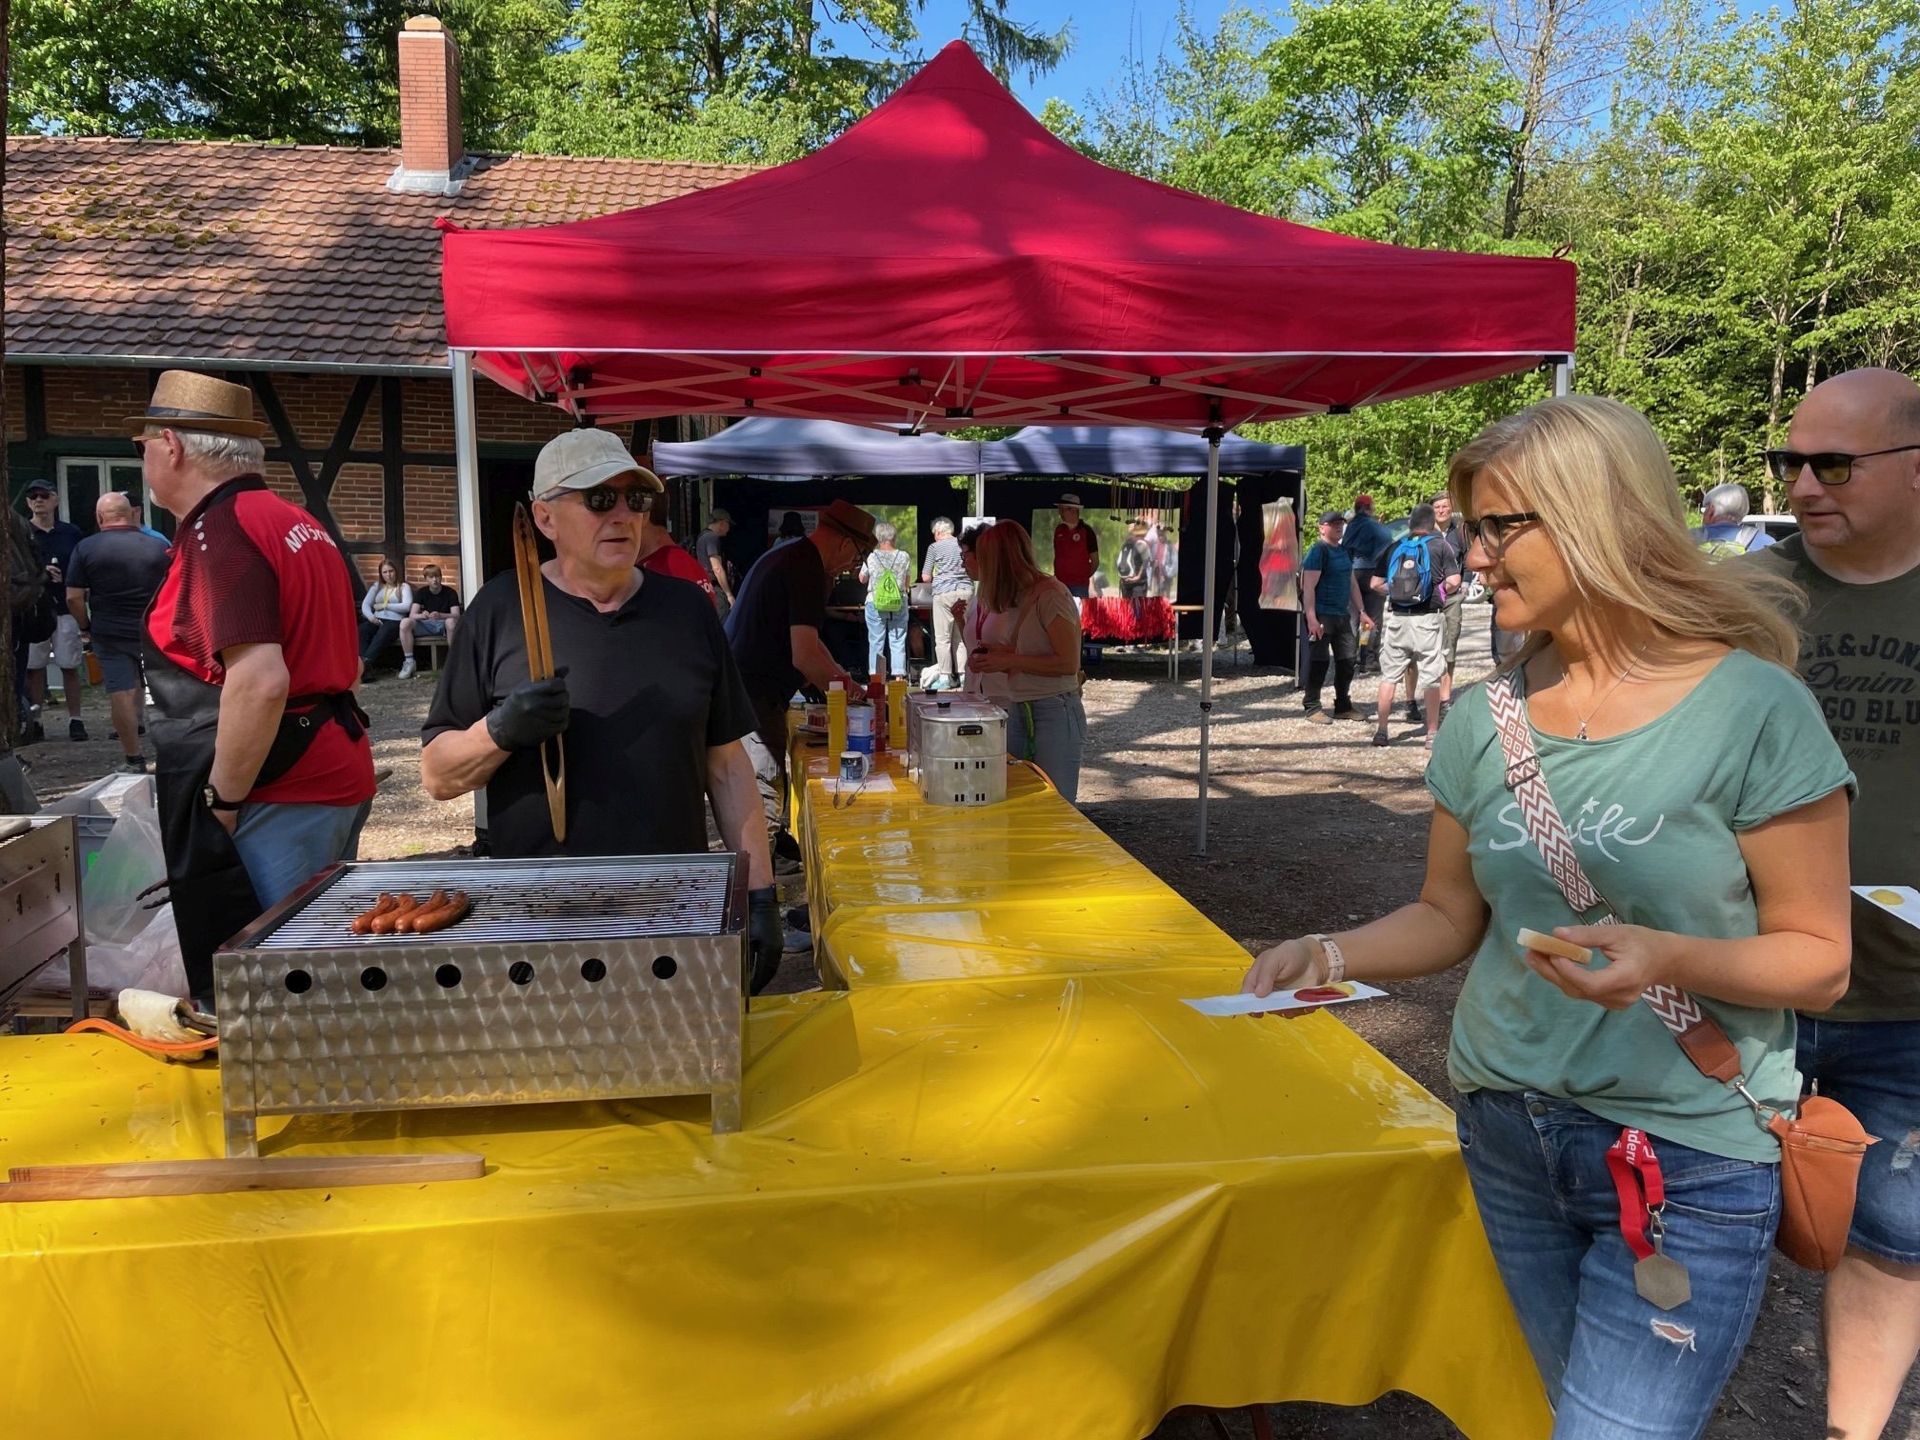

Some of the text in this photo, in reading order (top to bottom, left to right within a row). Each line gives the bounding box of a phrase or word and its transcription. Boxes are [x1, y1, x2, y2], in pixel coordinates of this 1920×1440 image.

[285, 522, 311, 553] MTV
[1808, 659, 1918, 694] Denim
[1488, 796, 1664, 862] Sile
